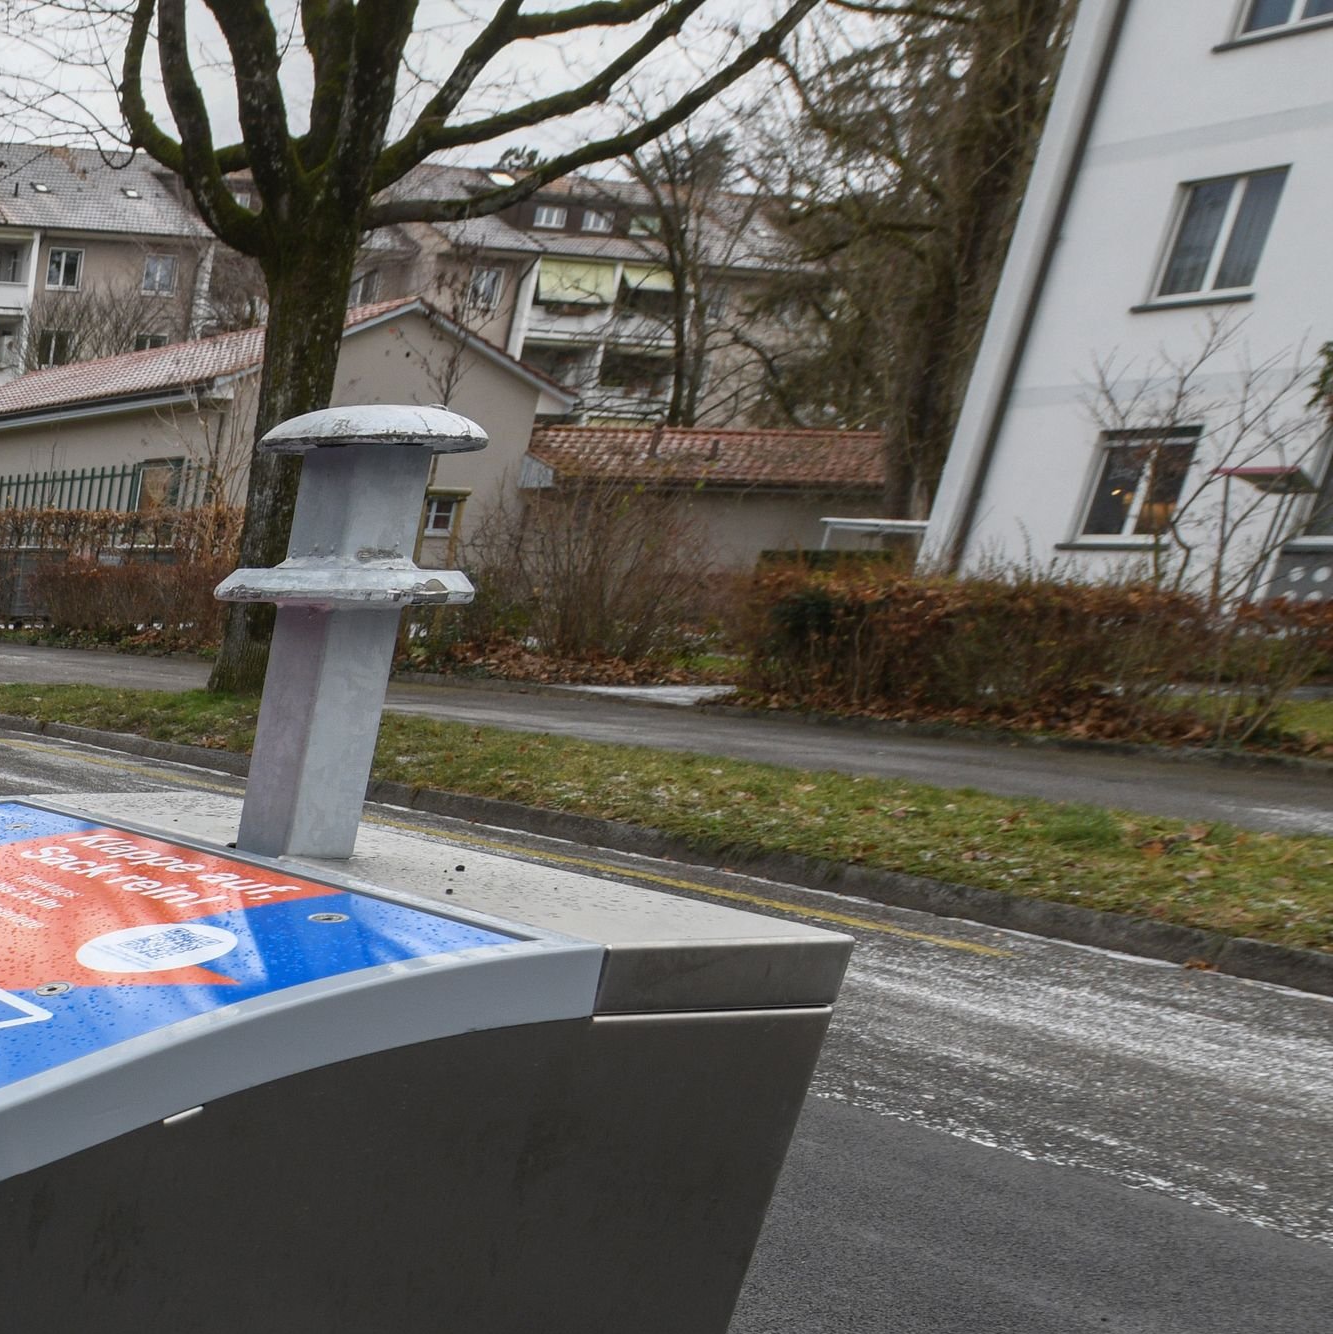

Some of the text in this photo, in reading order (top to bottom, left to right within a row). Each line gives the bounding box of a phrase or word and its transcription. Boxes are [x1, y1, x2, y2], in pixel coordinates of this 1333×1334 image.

[20, 845, 230, 909] Sack rein!
[66, 833, 302, 901] Klappe auf,
[31, 894, 65, 910] Uhr
